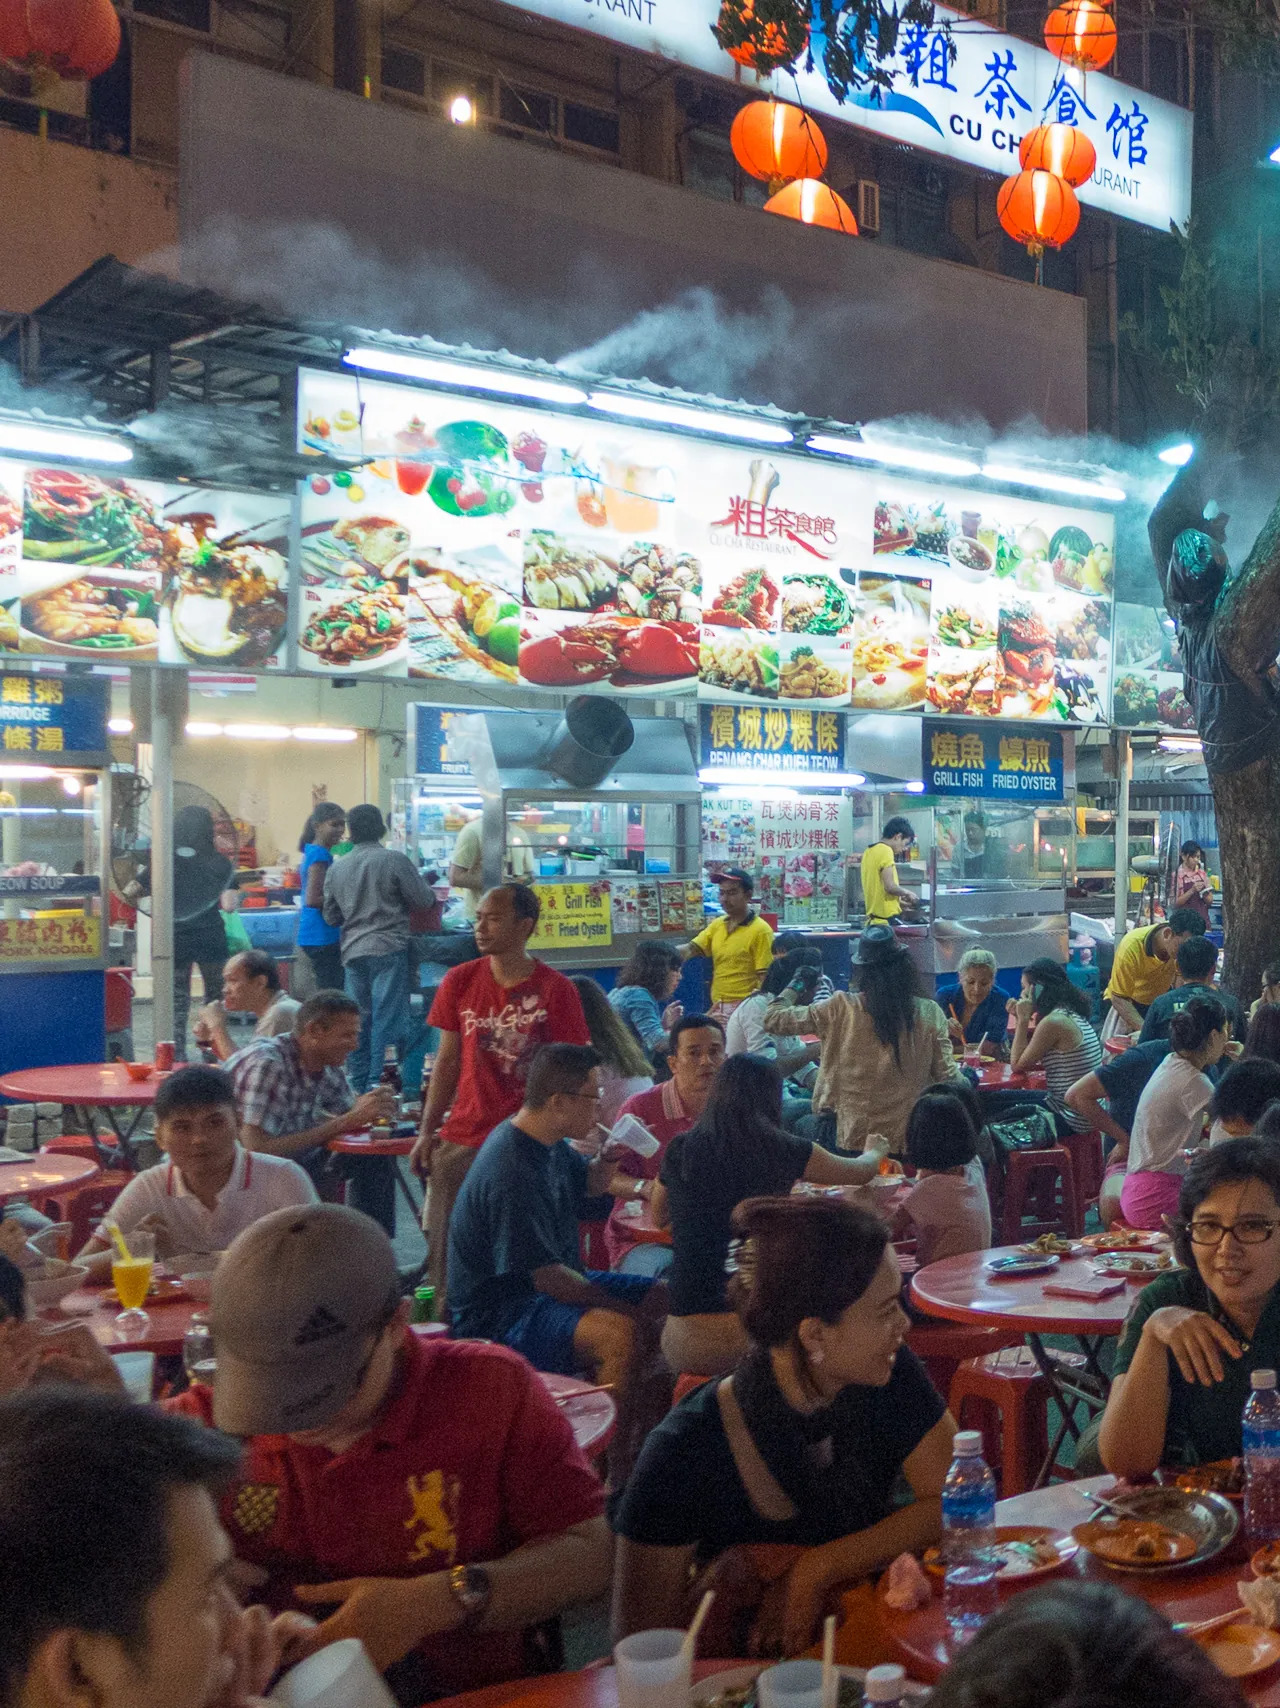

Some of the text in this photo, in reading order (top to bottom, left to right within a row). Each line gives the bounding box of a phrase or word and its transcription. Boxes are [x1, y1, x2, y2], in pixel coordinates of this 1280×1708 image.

[583, 0, 656, 24] RANT
[949, 114, 1024, 154] CU CH
[711, 705, 838, 752] 檳城炒粿條
[709, 751, 838, 771] PENANG CHAR KUEH TEOW
[933, 771, 1056, 791] GRILL FISH FRIED OYSTER
[717, 800, 733, 810] KUT
[31, 877, 65, 890] SOUP
[565, 895, 602, 909] Grill Fish
[559, 921, 607, 937] Fried Oyster
